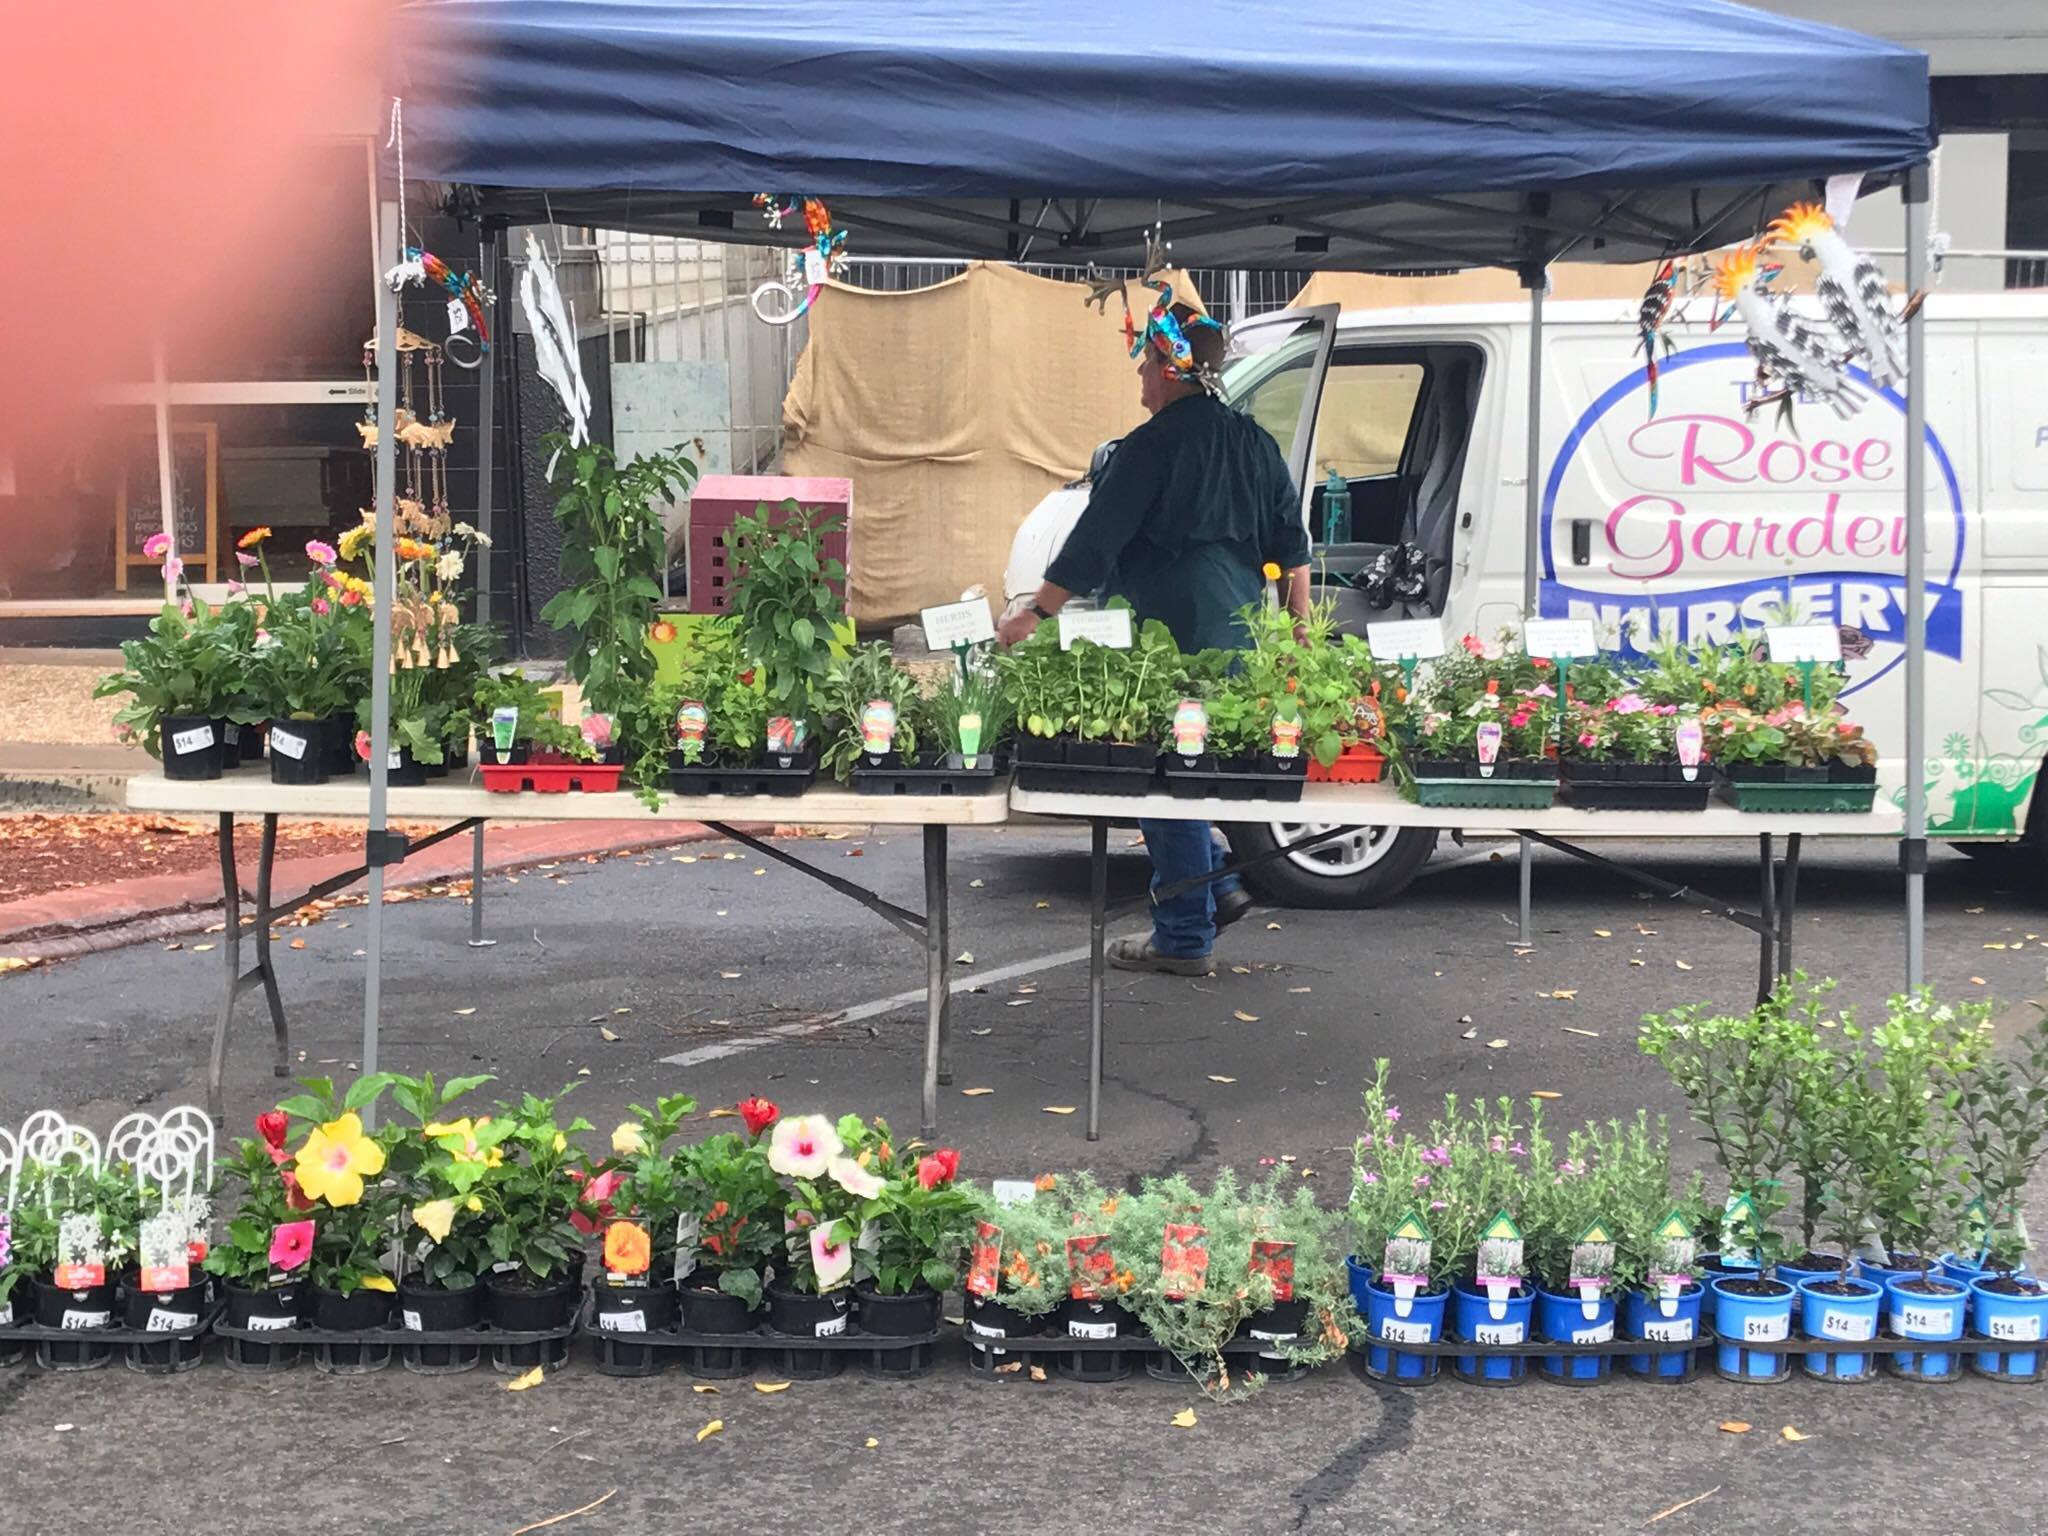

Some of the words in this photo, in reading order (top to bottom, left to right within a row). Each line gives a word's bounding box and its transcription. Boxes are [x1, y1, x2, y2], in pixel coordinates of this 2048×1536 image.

[1628, 414, 1894, 485] Rose
[175, 737, 193, 749] $14
[66, 1317, 88, 1330] $14
[151, 1315, 174, 1331] $14
[1826, 1316, 1849, 1331] $14
[1906, 1312, 1927, 1327] $14
[1385, 1326, 1406, 1342] $14
[1647, 1329, 1670, 1343] $14
[1748, 1322, 1769, 1336] $14
[1993, 1322, 2015, 1336] $14
[1479, 1332, 1500, 1345] $14
